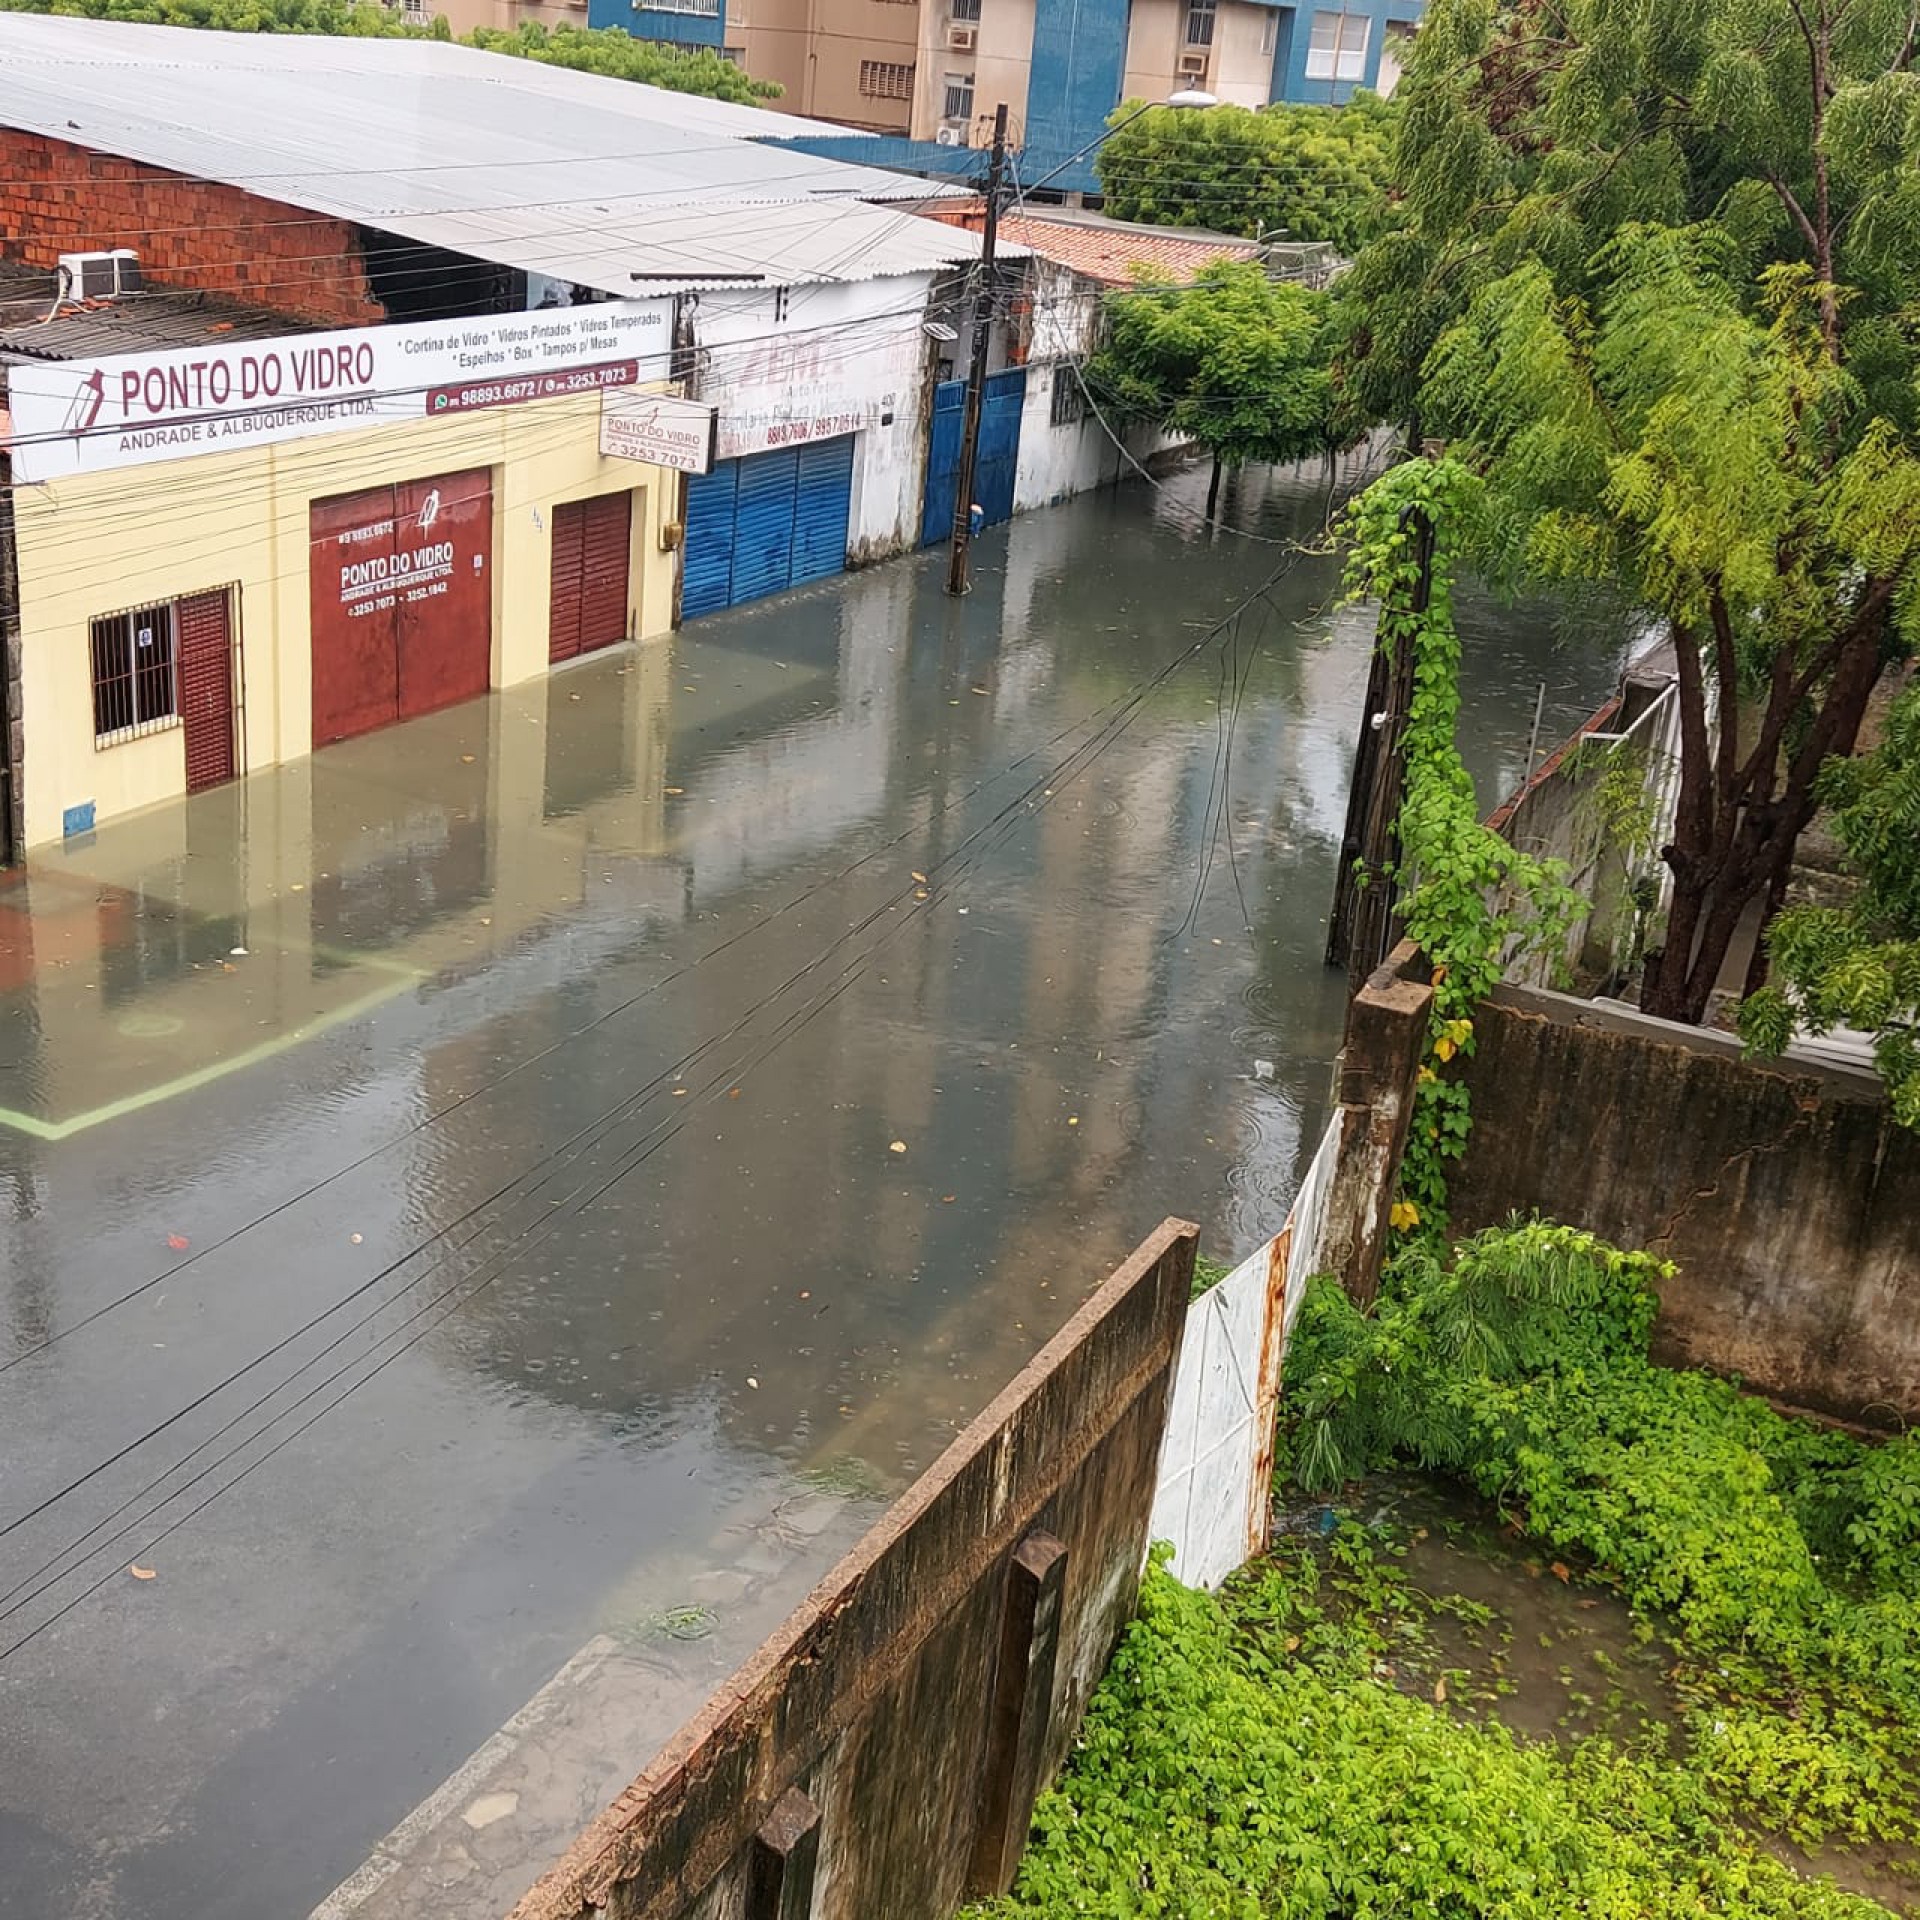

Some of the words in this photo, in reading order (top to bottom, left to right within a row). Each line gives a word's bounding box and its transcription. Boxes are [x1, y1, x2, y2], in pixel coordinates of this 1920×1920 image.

[405, 336, 444, 354] Cortina
[447, 335, 459, 348] de
[462, 332, 489, 347] Vidro
[498, 327, 529, 342] Vidros
[531, 323, 571, 340] Pintados
[580, 318, 608, 333] Vidros
[610, 312, 662, 330] Temperados
[459, 351, 505, 369] Espelhos
[514, 346, 532, 360] Box
[542, 342, 577, 357] Tampos
[591, 336, 618, 349] Mesas
[121, 358, 231, 417] PONTO
[241, 353, 283, 400] DO
[291, 342, 374, 392] VIDRO
[461, 380, 535, 406] 98893.6672
[567, 366, 627, 389] 3253.7073
[120, 424, 201, 451] ANDRADE
[206, 420, 217, 439] &
[221, 405, 335, 436] ALBUQUERQUE
[608, 418, 646, 434] PONTO
[648, 425, 664, 437] DO
[667, 431, 700, 445] VIDRO
[620, 444, 656, 460] 3253
[661, 452, 697, 469] 7073
[341, 557, 388, 589] PONTO
[390, 552, 411, 575] DO
[413, 542, 454, 569] VIDRO
